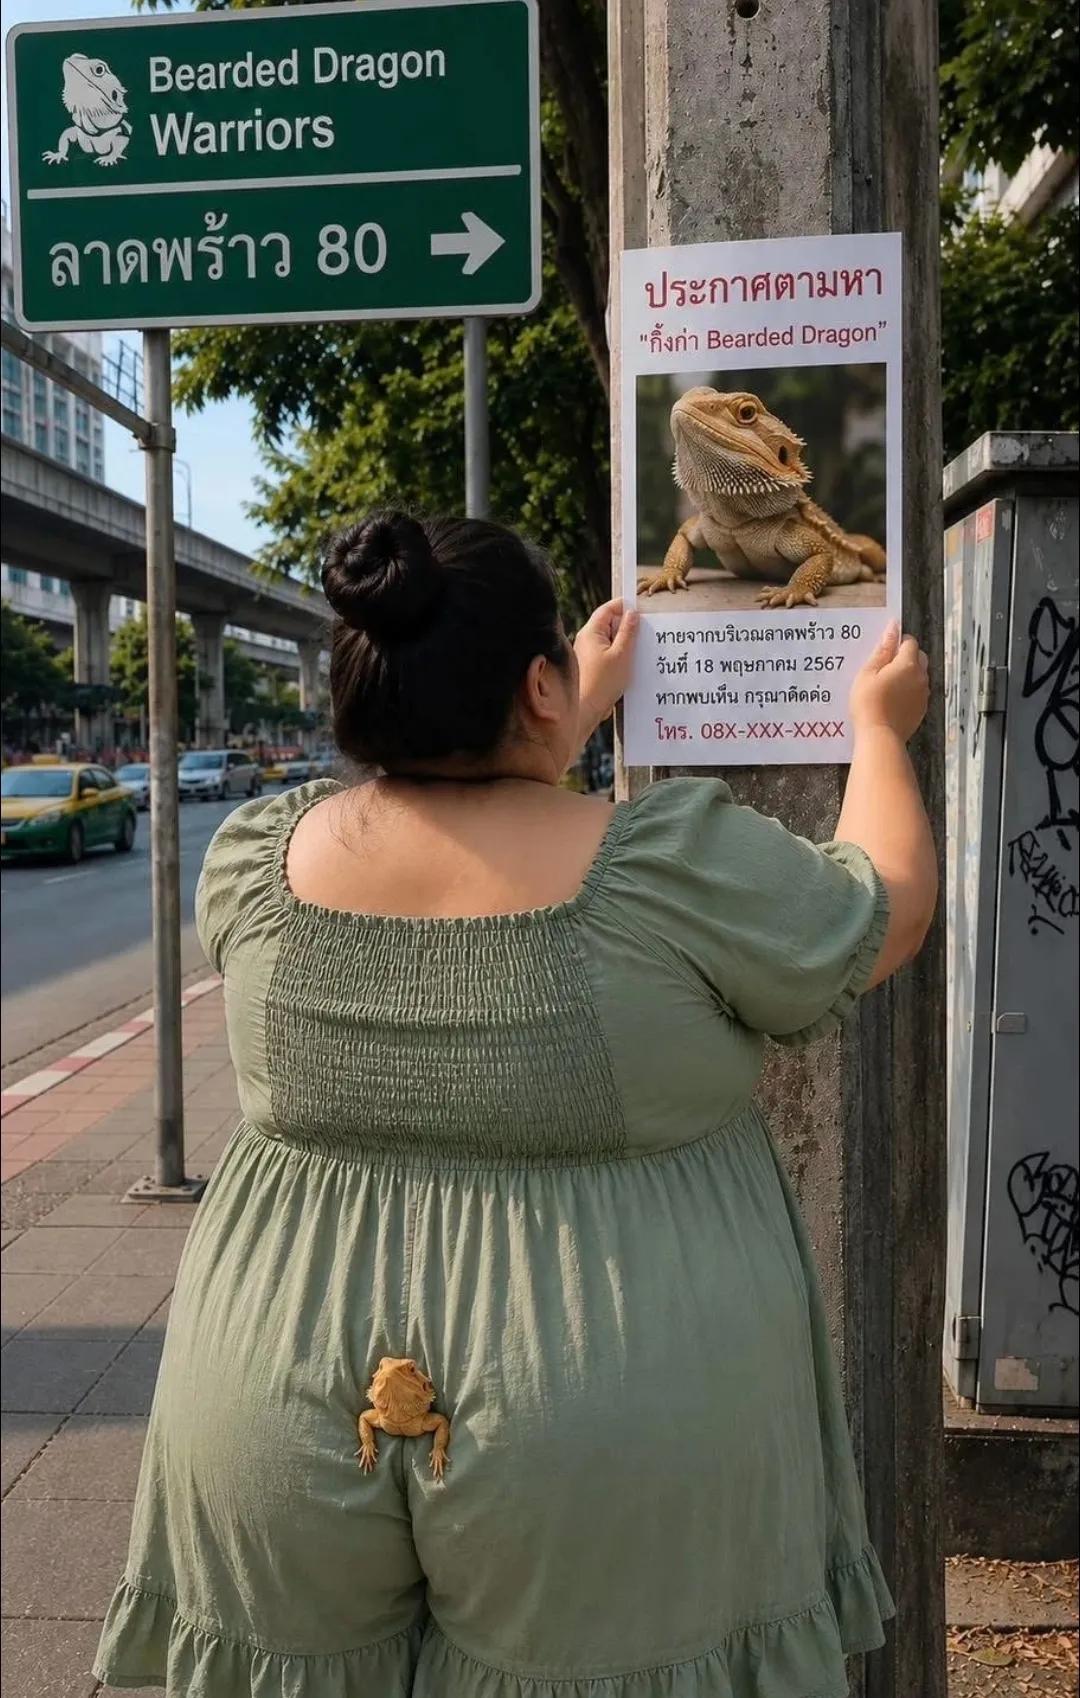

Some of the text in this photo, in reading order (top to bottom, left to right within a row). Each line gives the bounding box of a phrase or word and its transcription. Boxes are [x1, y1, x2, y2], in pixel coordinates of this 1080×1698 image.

[149, 46, 446, 93] Bearded Dragon
[150, 108, 335, 156] Warriors
[49, 212, 388, 287] ลาดพร้าว 80
[645, 268, 883, 308] ประกาศตามหา
[707, 325, 793, 350] Bearded
[656, 621, 861, 644] หายจากบริเวณลาดพร้าว 80
[656, 652, 688, 674] วันที่
[695, 659, 714, 674] 18
[803, 656, 845, 672] 2567
[654, 717, 845, 740] โทร. 08X-XXX-XXXX
